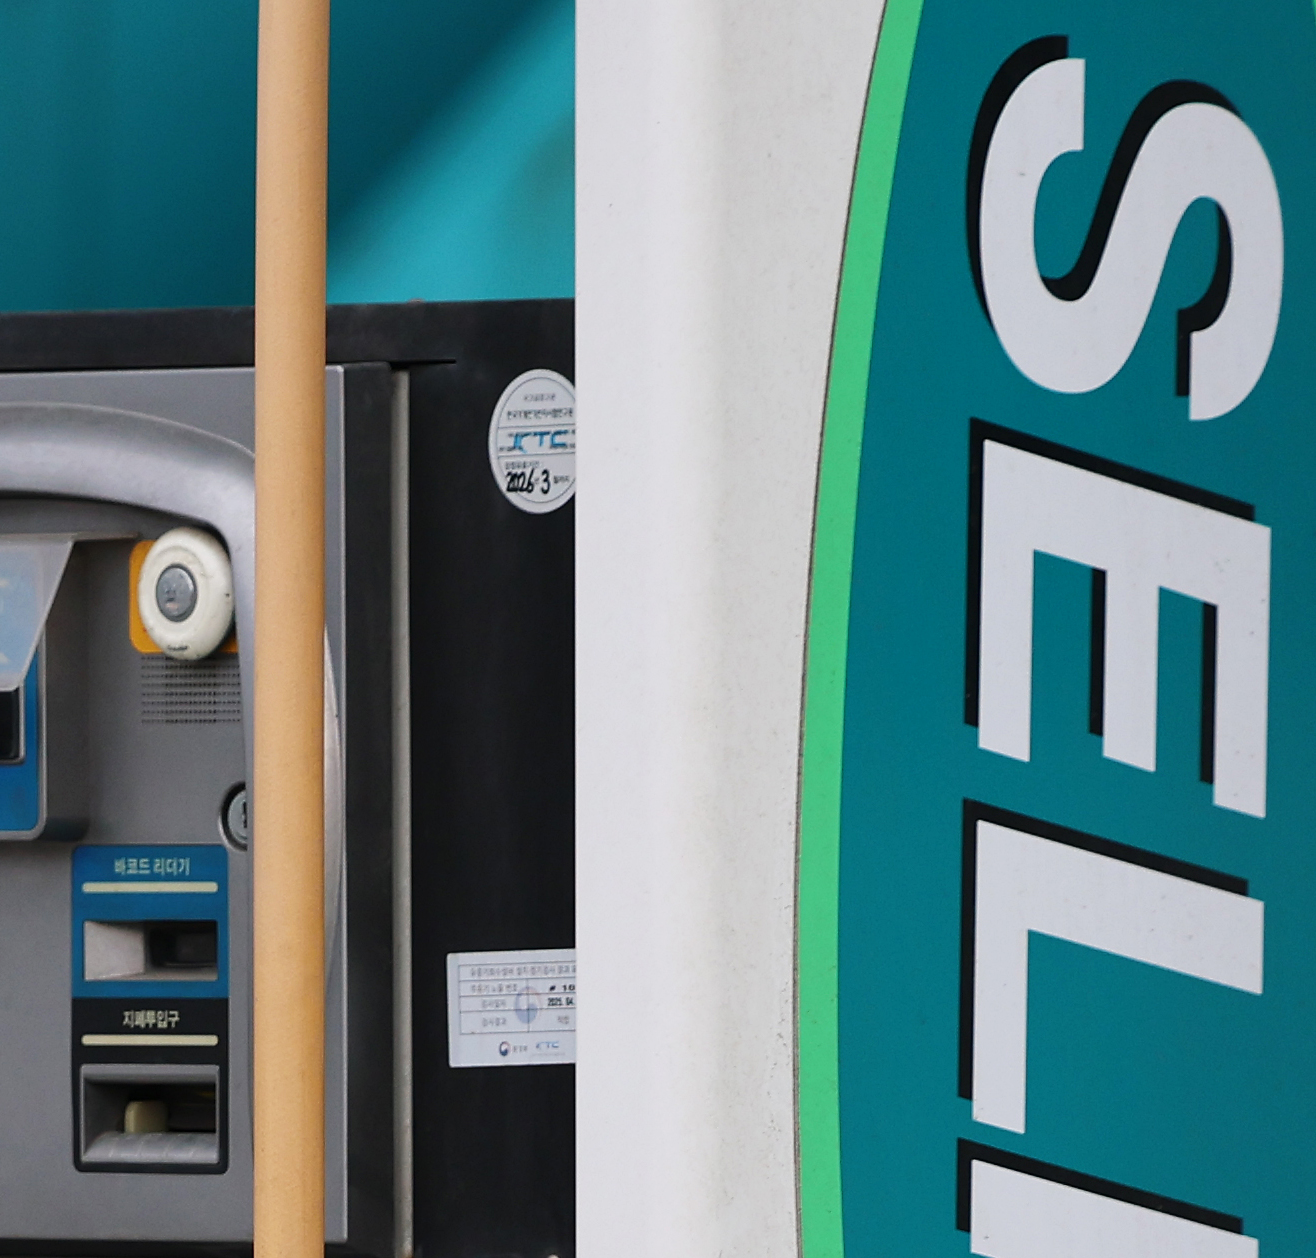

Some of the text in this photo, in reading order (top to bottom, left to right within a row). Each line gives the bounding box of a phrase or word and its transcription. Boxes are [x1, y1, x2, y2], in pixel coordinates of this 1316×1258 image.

[541, 468, 551, 494] 3
[114, 857, 190, 875] 바코드 리더기
[122, 1010, 180, 1028] 지폐투입구
